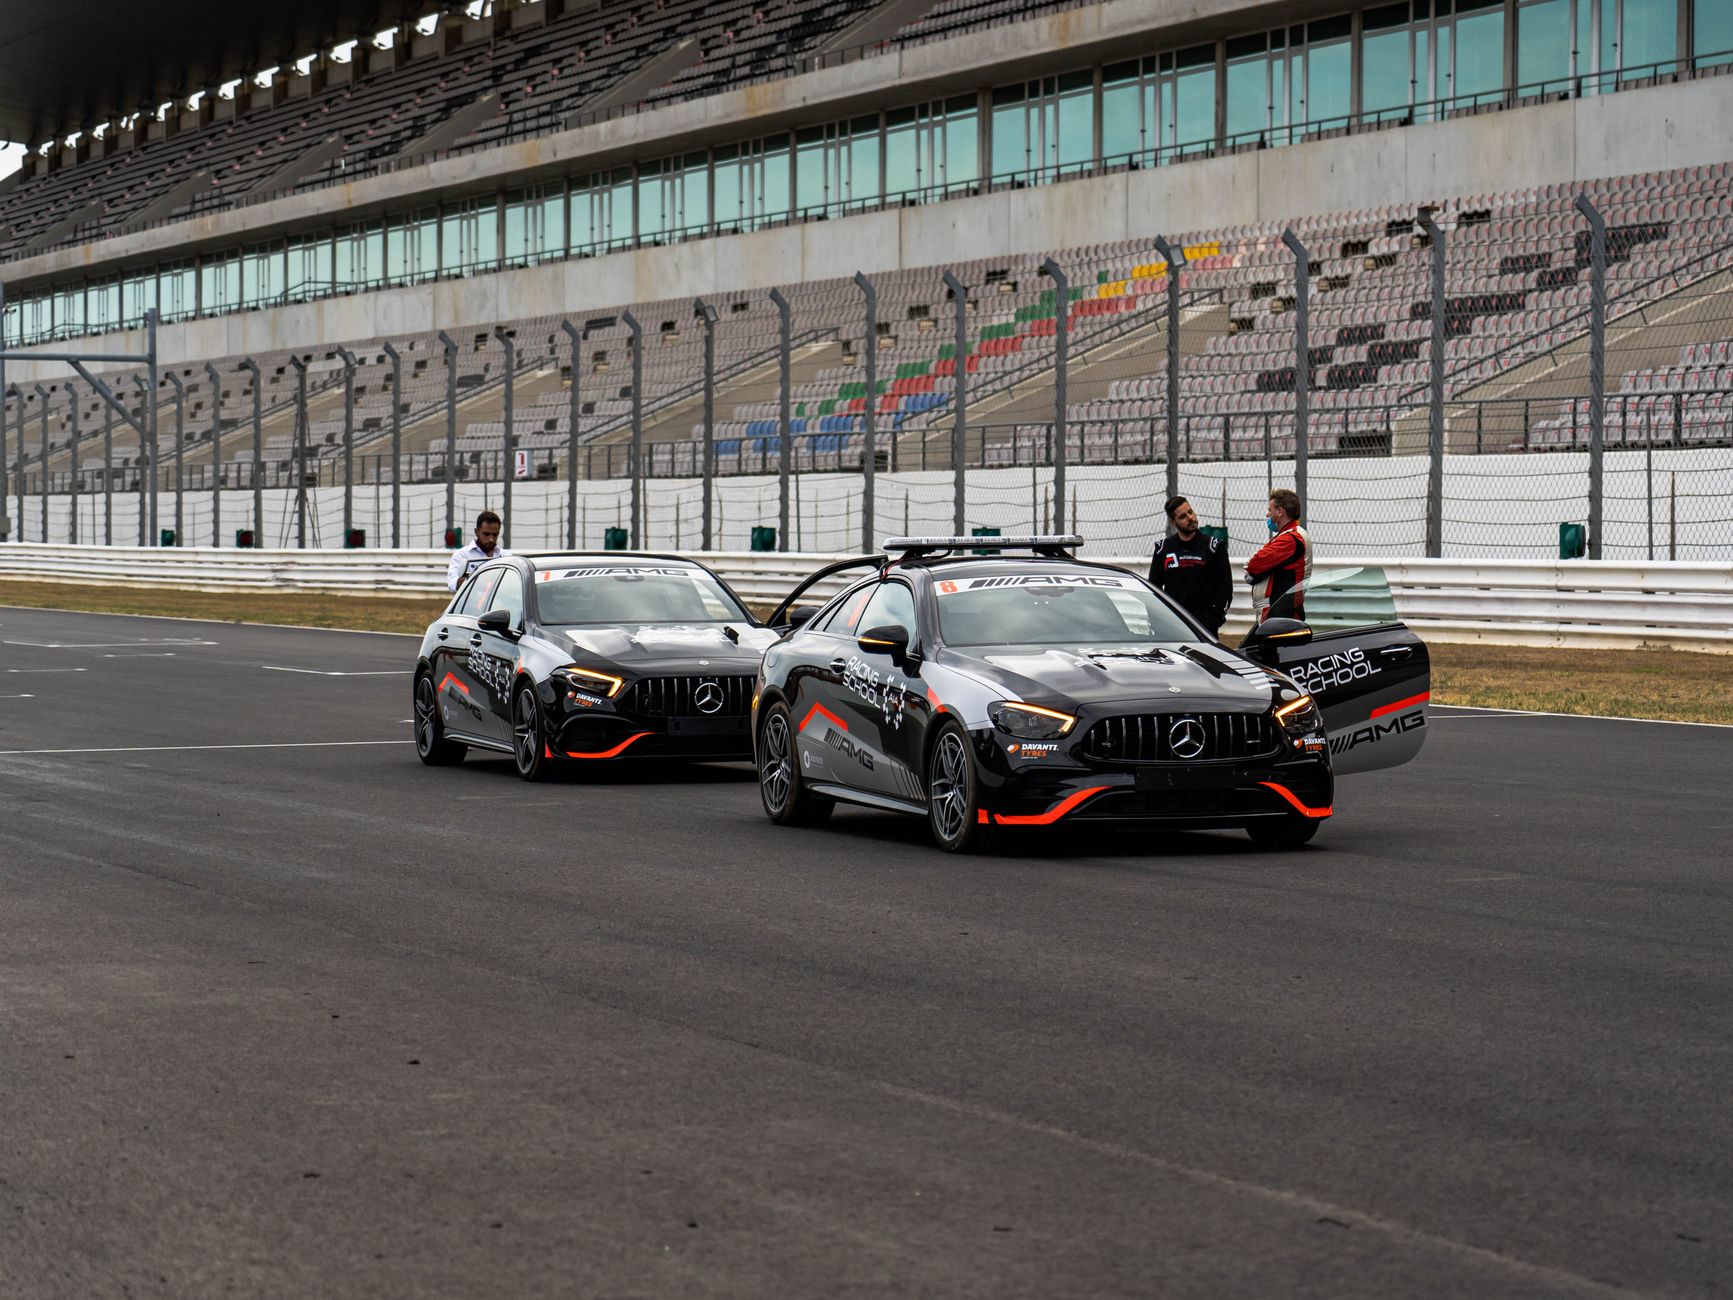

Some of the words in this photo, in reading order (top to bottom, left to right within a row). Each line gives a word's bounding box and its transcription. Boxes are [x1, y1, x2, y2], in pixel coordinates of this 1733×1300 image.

[541, 570, 550, 581] 1
[603, 567, 689, 577] AMG
[939, 580, 958, 593] 8
[1017, 576, 1123, 587] AMG
[468, 656, 495, 688] SCHOOL
[846, 655, 880, 686] RACING
[1289, 647, 1365, 681] RACING
[842, 671, 881, 709] SCHOOL
[1348, 709, 1426, 751] AMG
[839, 737, 875, 772] AMG
